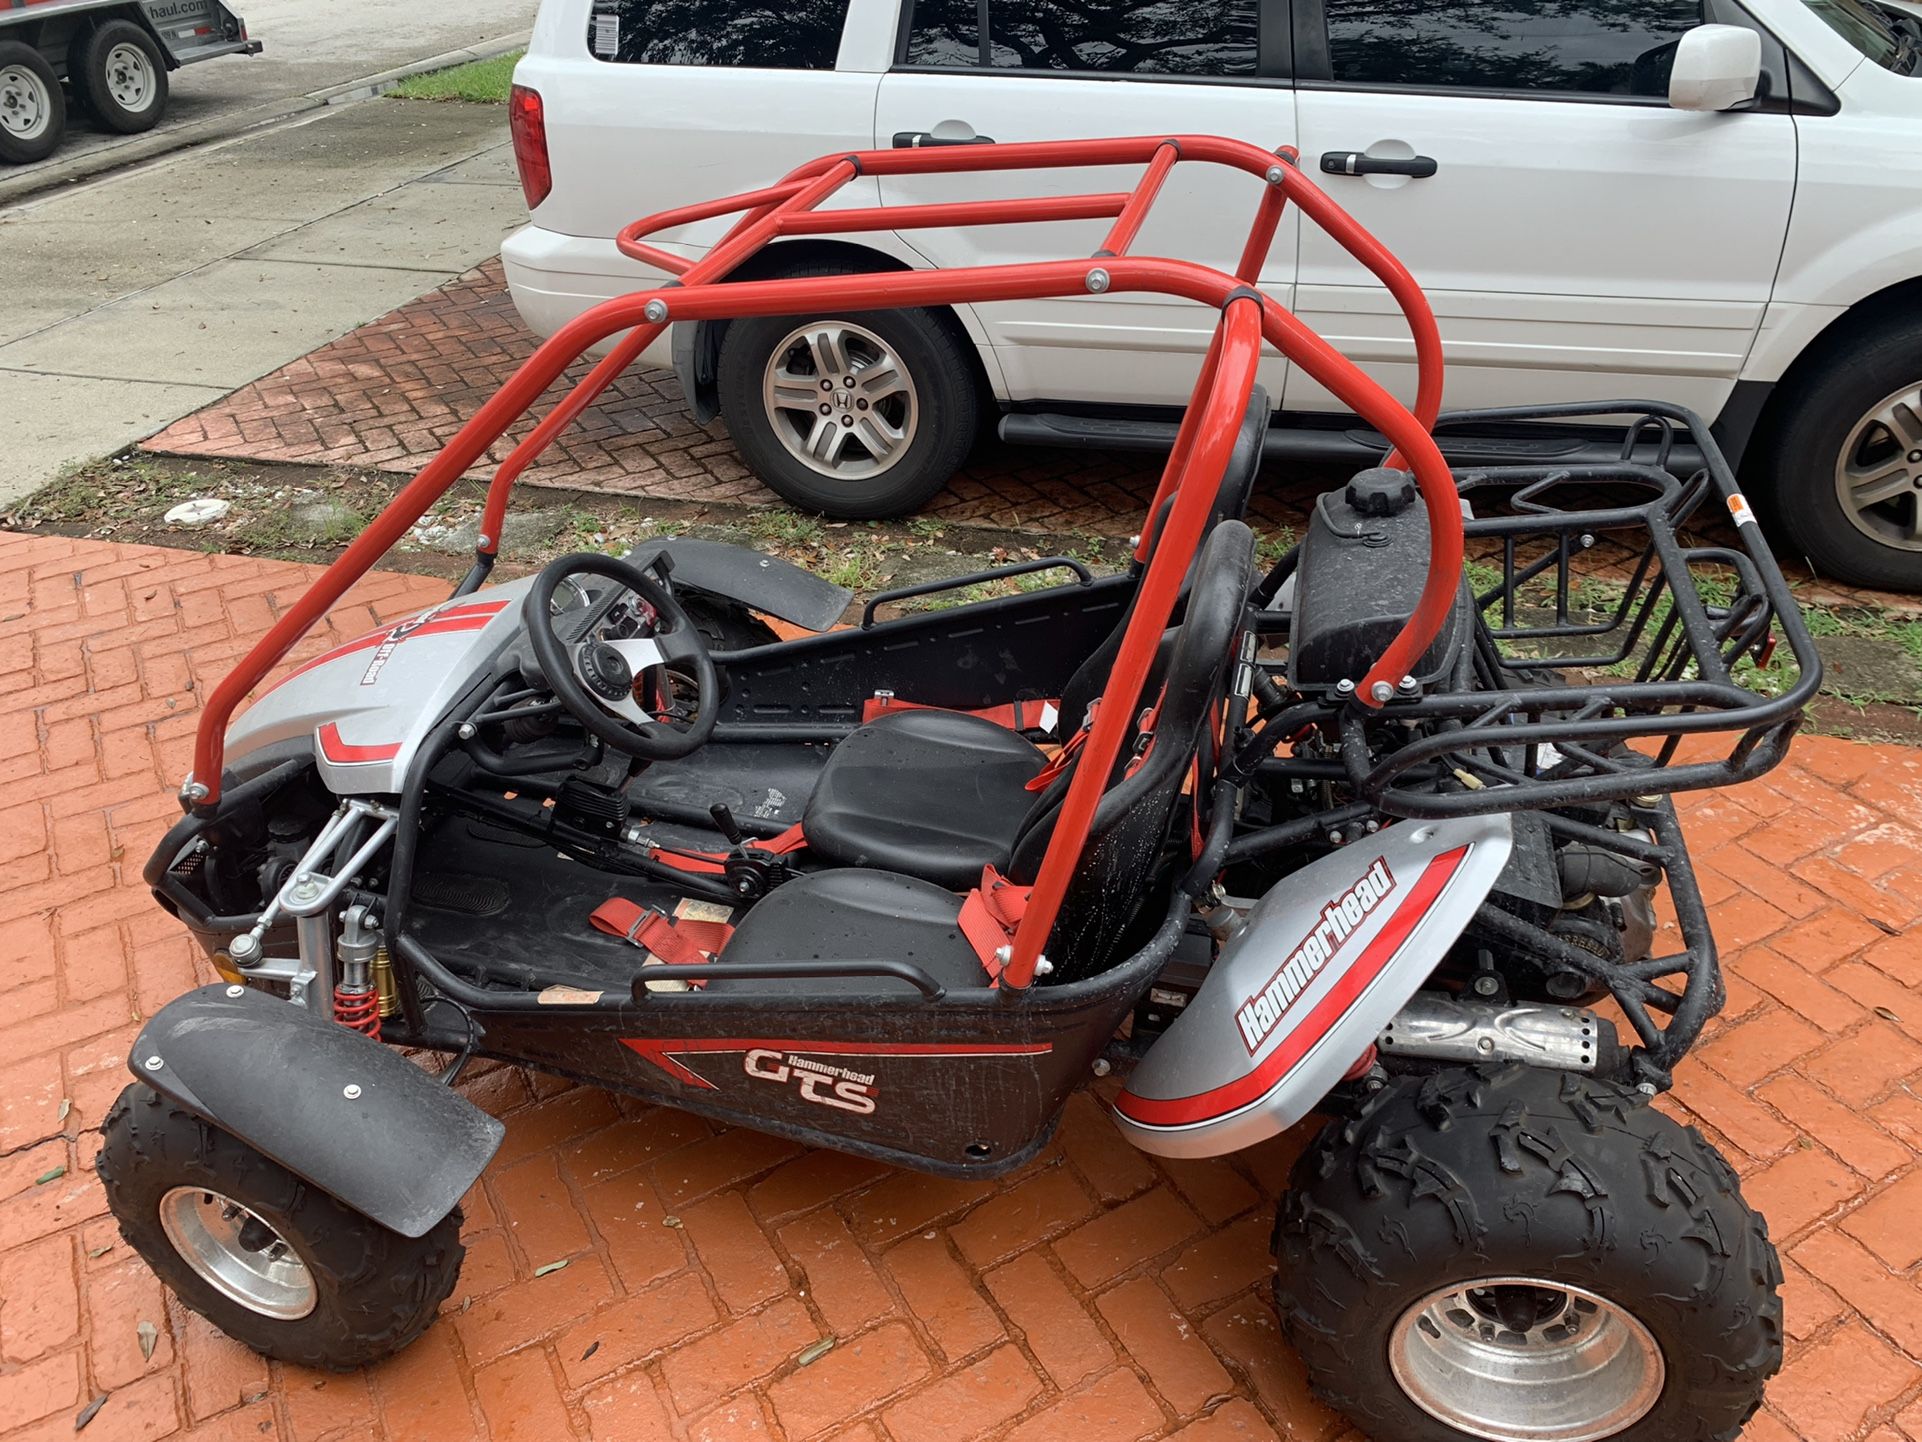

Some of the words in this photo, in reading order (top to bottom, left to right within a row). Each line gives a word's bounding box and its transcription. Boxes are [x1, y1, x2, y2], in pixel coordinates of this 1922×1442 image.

[1237, 859, 1393, 1052] Hammerhead
[745, 1049, 876, 1114] GTS
[788, 1055, 875, 1086] Hammerhead
